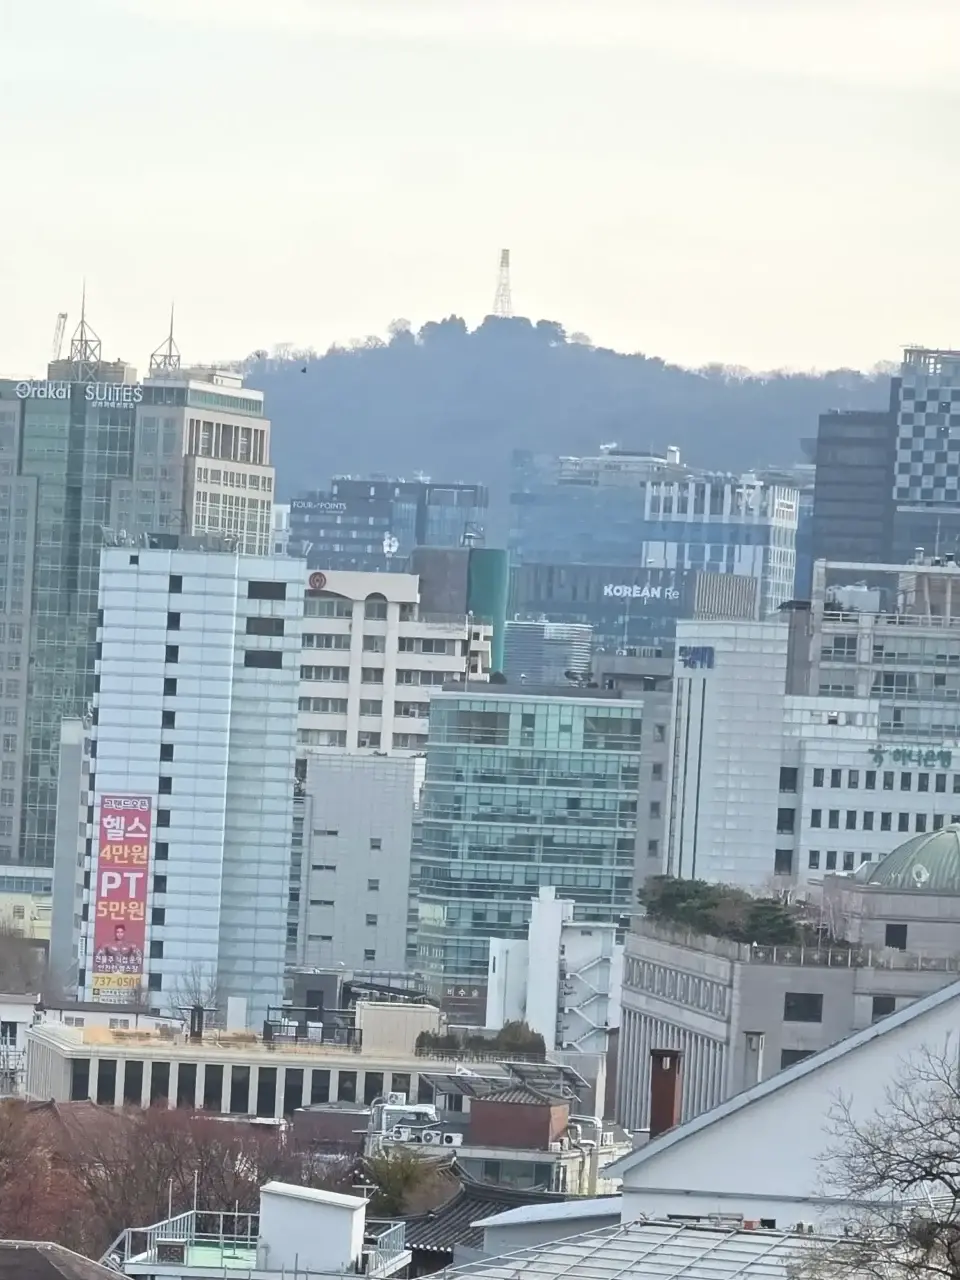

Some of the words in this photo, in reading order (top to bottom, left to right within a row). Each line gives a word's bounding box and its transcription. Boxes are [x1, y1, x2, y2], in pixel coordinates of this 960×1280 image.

[14, 382, 72, 399] Orakai
[85, 384, 143, 402] SUITES
[292, 501, 313, 509] FOUR
[320, 502, 347, 510] POINTS
[603, 583, 662, 598] KOREAN
[664, 587, 680, 599] Re
[892, 748, 952, 768] 하나은행
[103, 798, 149, 811] 그랜드오픈
[102, 814, 148, 840] 헬스
[100, 844, 147, 864] 4만원
[101, 871, 144, 898] PT
[97, 901, 144, 920] 5만원
